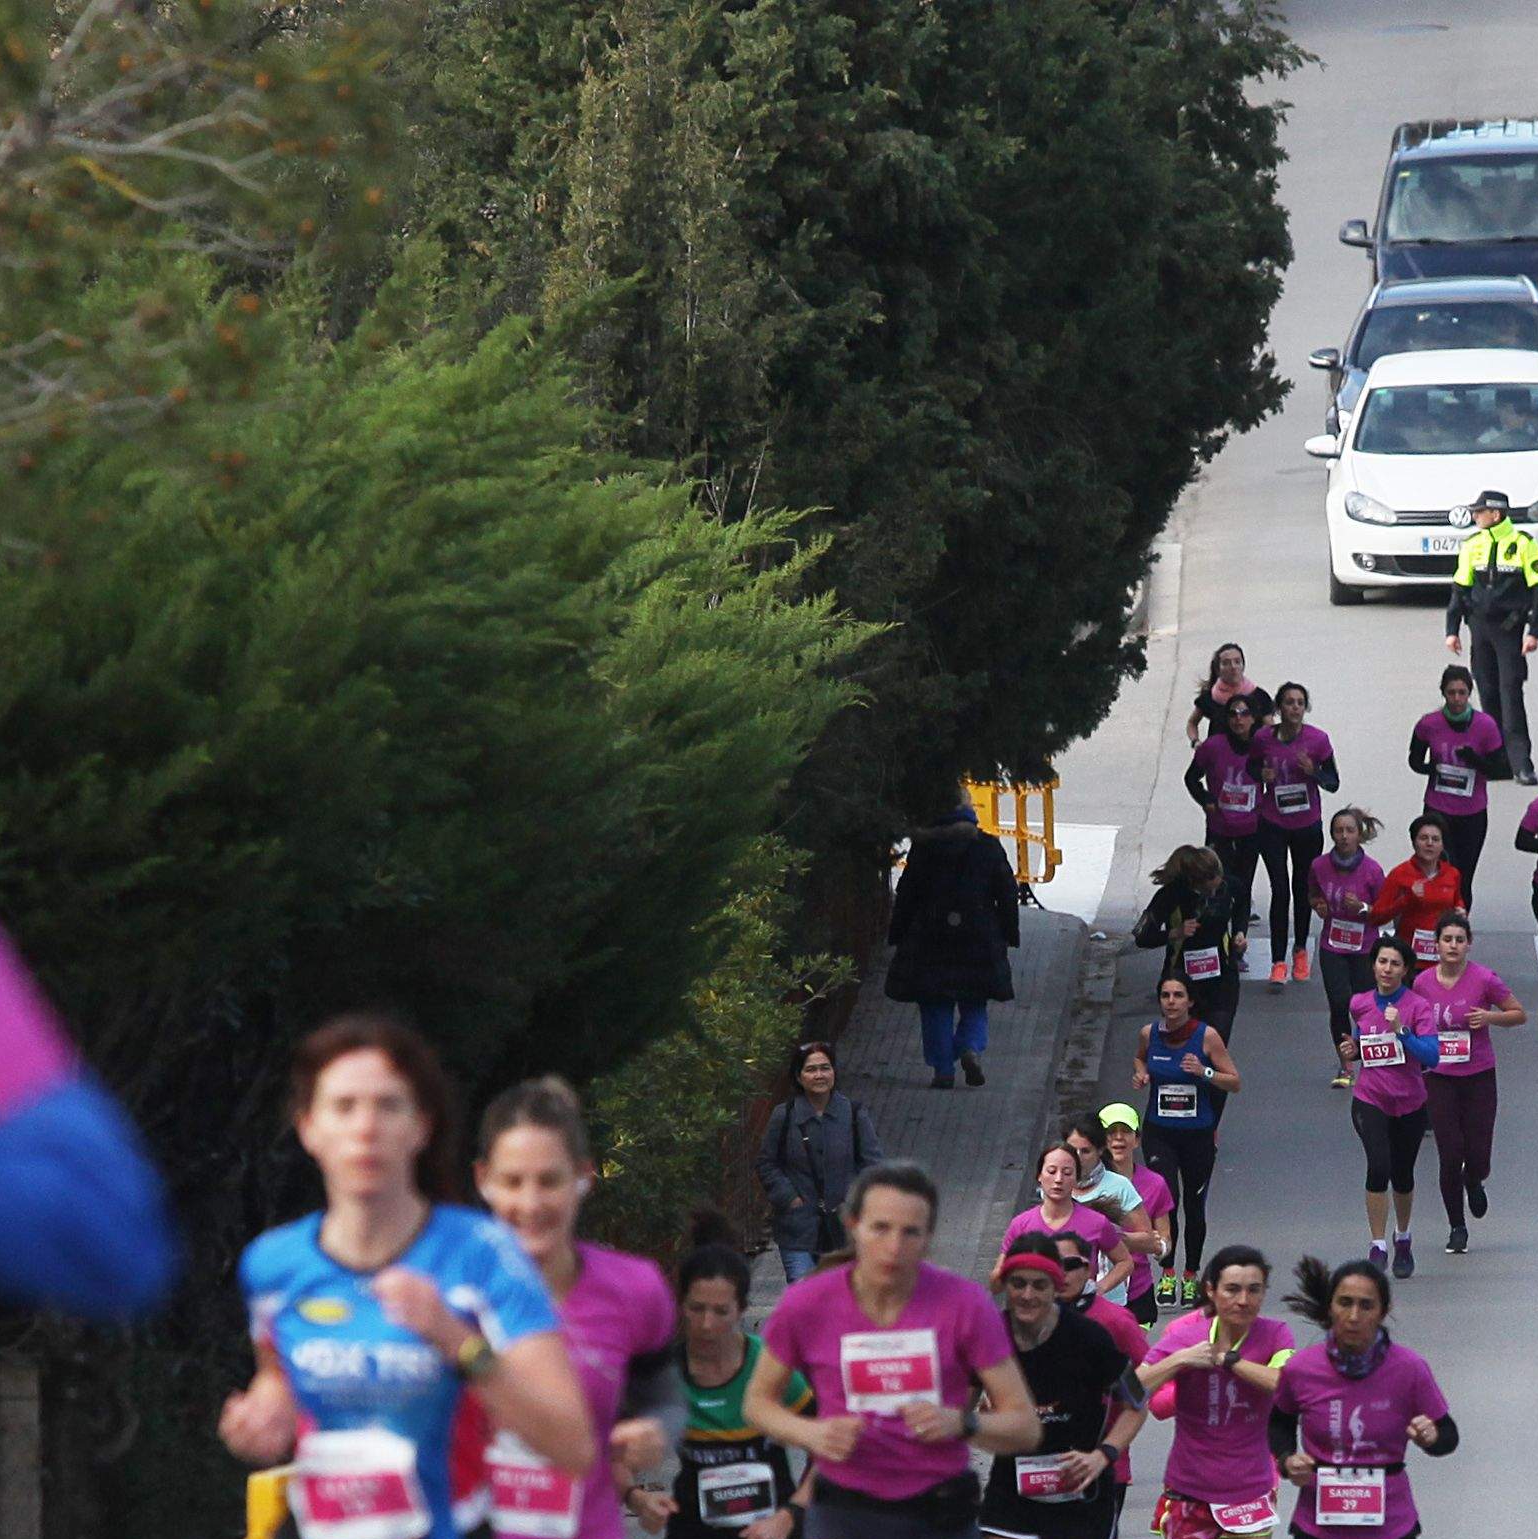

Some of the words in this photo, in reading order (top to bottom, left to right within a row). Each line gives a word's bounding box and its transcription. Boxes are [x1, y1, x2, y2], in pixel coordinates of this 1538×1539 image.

[1433, 539, 1461, 552] 047
[1367, 1045, 1390, 1059] 139
[712, 1485, 759, 1500] SUSANA
[1328, 1488, 1372, 1499] SANDRA
[1221, 1502, 1262, 1518] CRISTINA
[1342, 1500, 1358, 1510] 39
